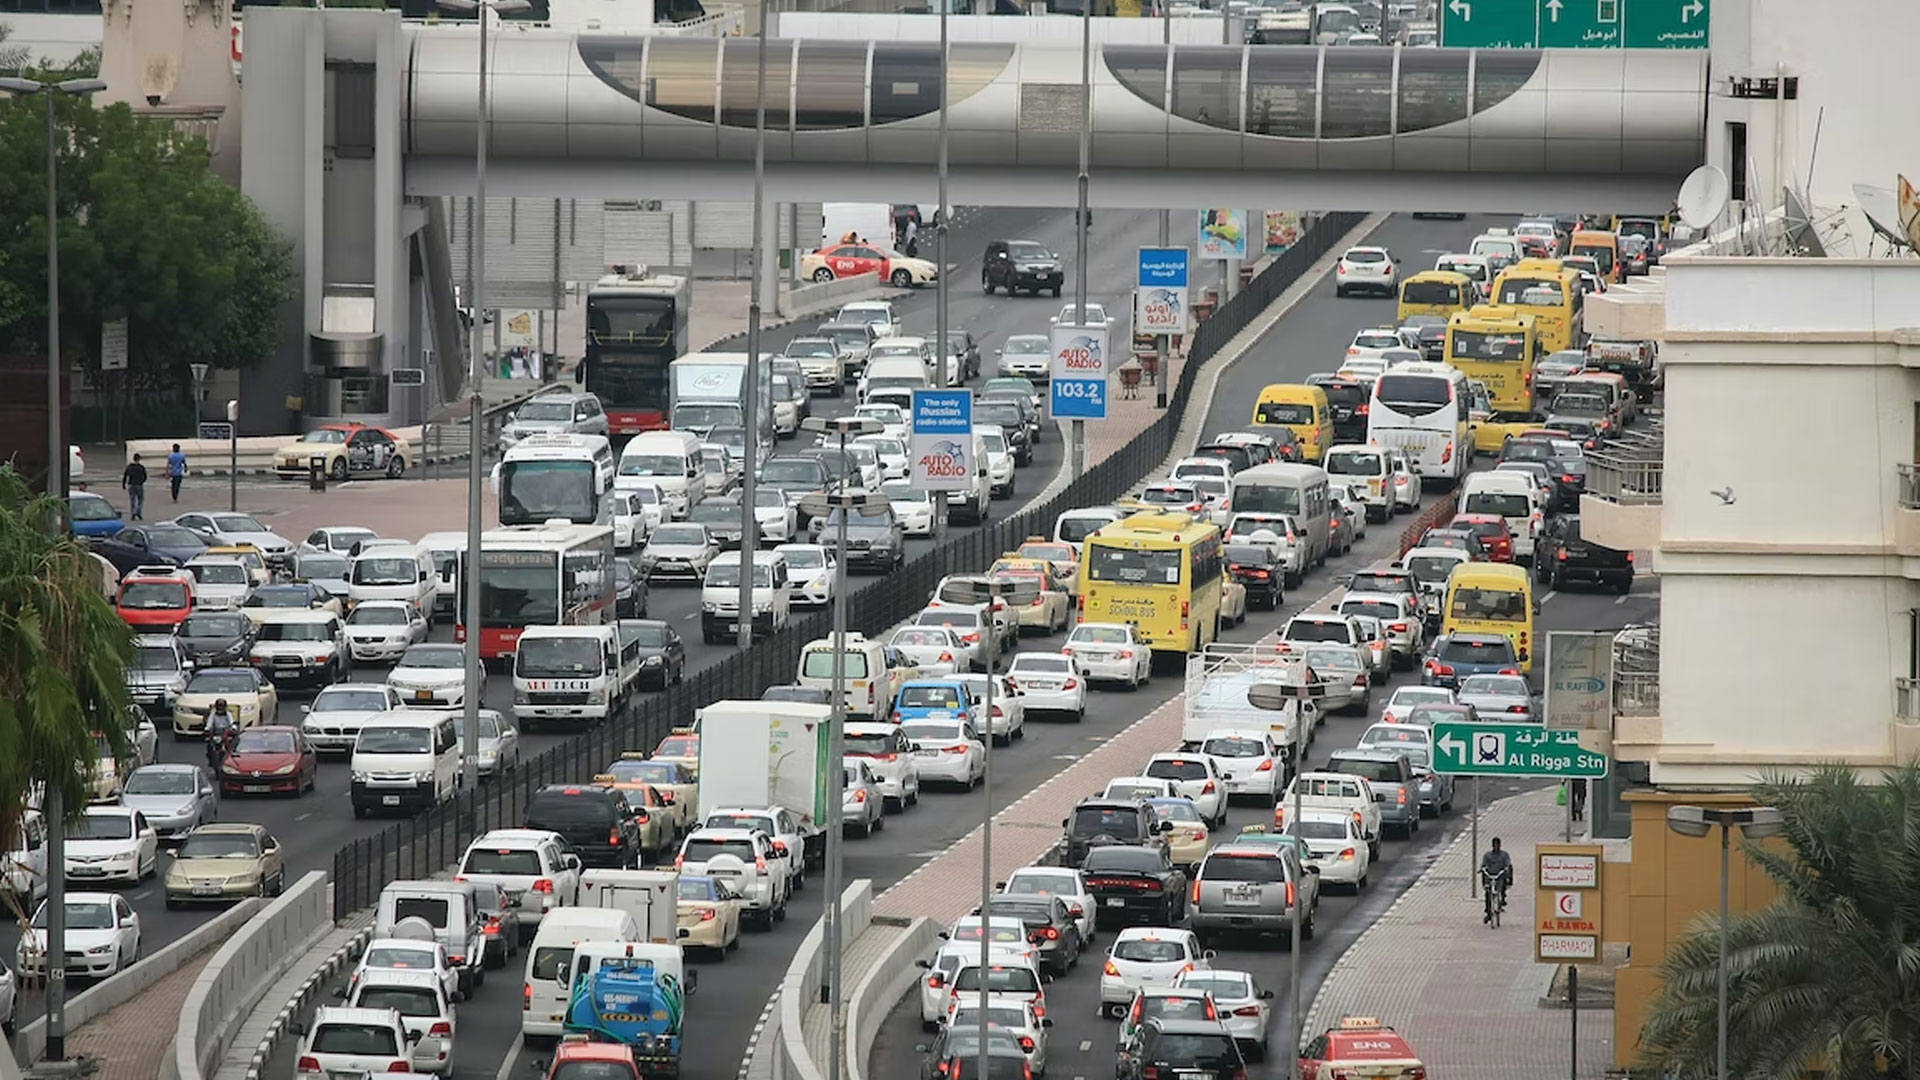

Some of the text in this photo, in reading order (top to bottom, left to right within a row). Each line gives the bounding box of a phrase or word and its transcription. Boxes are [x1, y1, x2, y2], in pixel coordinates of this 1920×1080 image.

[1058, 348, 1090, 359] AUTO
[1066, 359, 1102, 369] RADIO
[1055, 382, 1099, 399] 103.2
[924, 398, 960, 408] The only
[920, 407, 962, 416] Russian
[916, 418, 967, 426] radio station
[918, 455, 952, 466] AUTO
[927, 465, 966, 477] RADIO
[1109, 605, 1156, 618] SCHOOL BUS
[1515, 729, 1549, 747] الرقة
[1508, 753, 1604, 771] Al Rigga Stn
[1542, 858, 1595, 872] صيدلية
[1543, 872, 1594, 884] الروضة
[1542, 921, 1595, 931] AL RAWDA
[1542, 940, 1594, 953] PHARMACY
[1352, 1041, 1391, 1050] ENG
